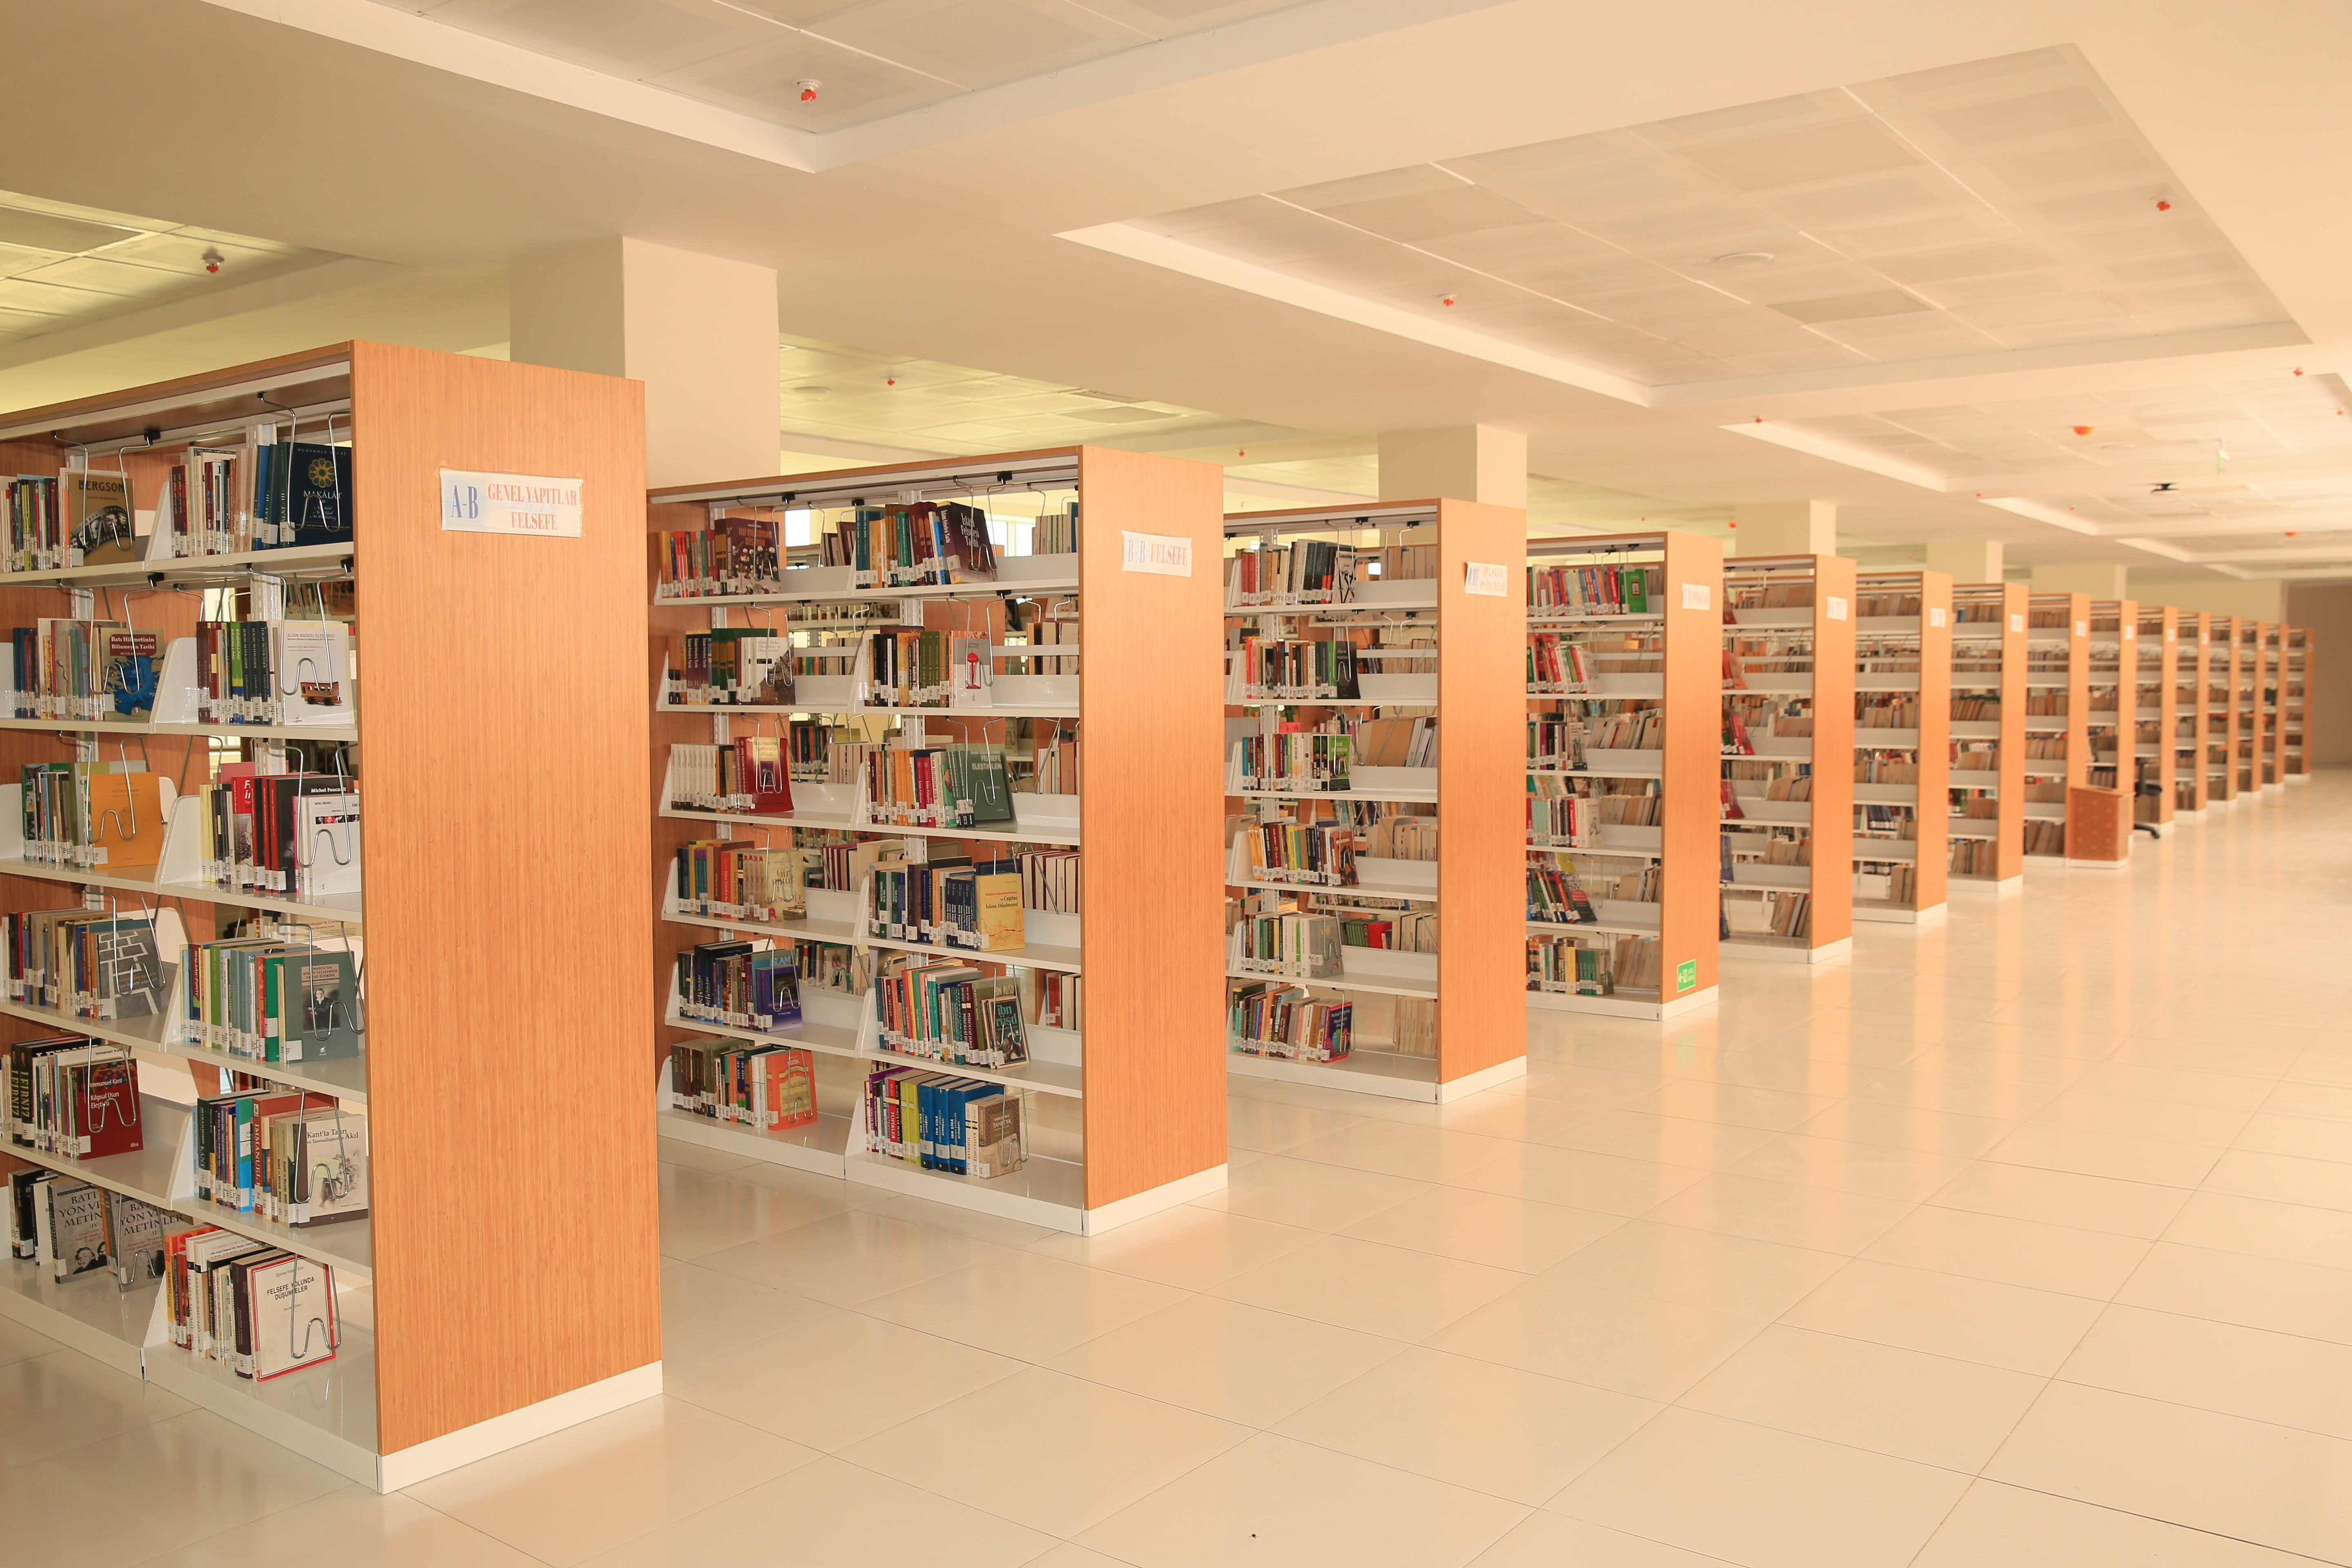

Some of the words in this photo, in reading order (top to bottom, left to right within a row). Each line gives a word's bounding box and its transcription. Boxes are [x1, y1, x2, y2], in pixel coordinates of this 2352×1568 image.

[78, 480, 125, 493] BERGSON
[487, 483, 524, 502] GENEL
[526, 486, 577, 506] YAPITLAR
[451, 484, 479, 519] A-B
[511, 512, 558, 530] FELSEFE
[1150, 543, 1188, 566] FELSEFE
[997, 1004, 1012, 1016] ibn
[89, 1079, 112, 1088] Immanuel
[20, 1071, 29, 1118] LEIBNIZ
[90, 1092, 107, 1102] Kılgısal
[306, 1130, 330, 1138] Kant'ta
[60, 1203, 85, 1218] YÖN
[120, 1213, 146, 1225] YÖN
[267, 1283, 289, 1296] FELSEFE
